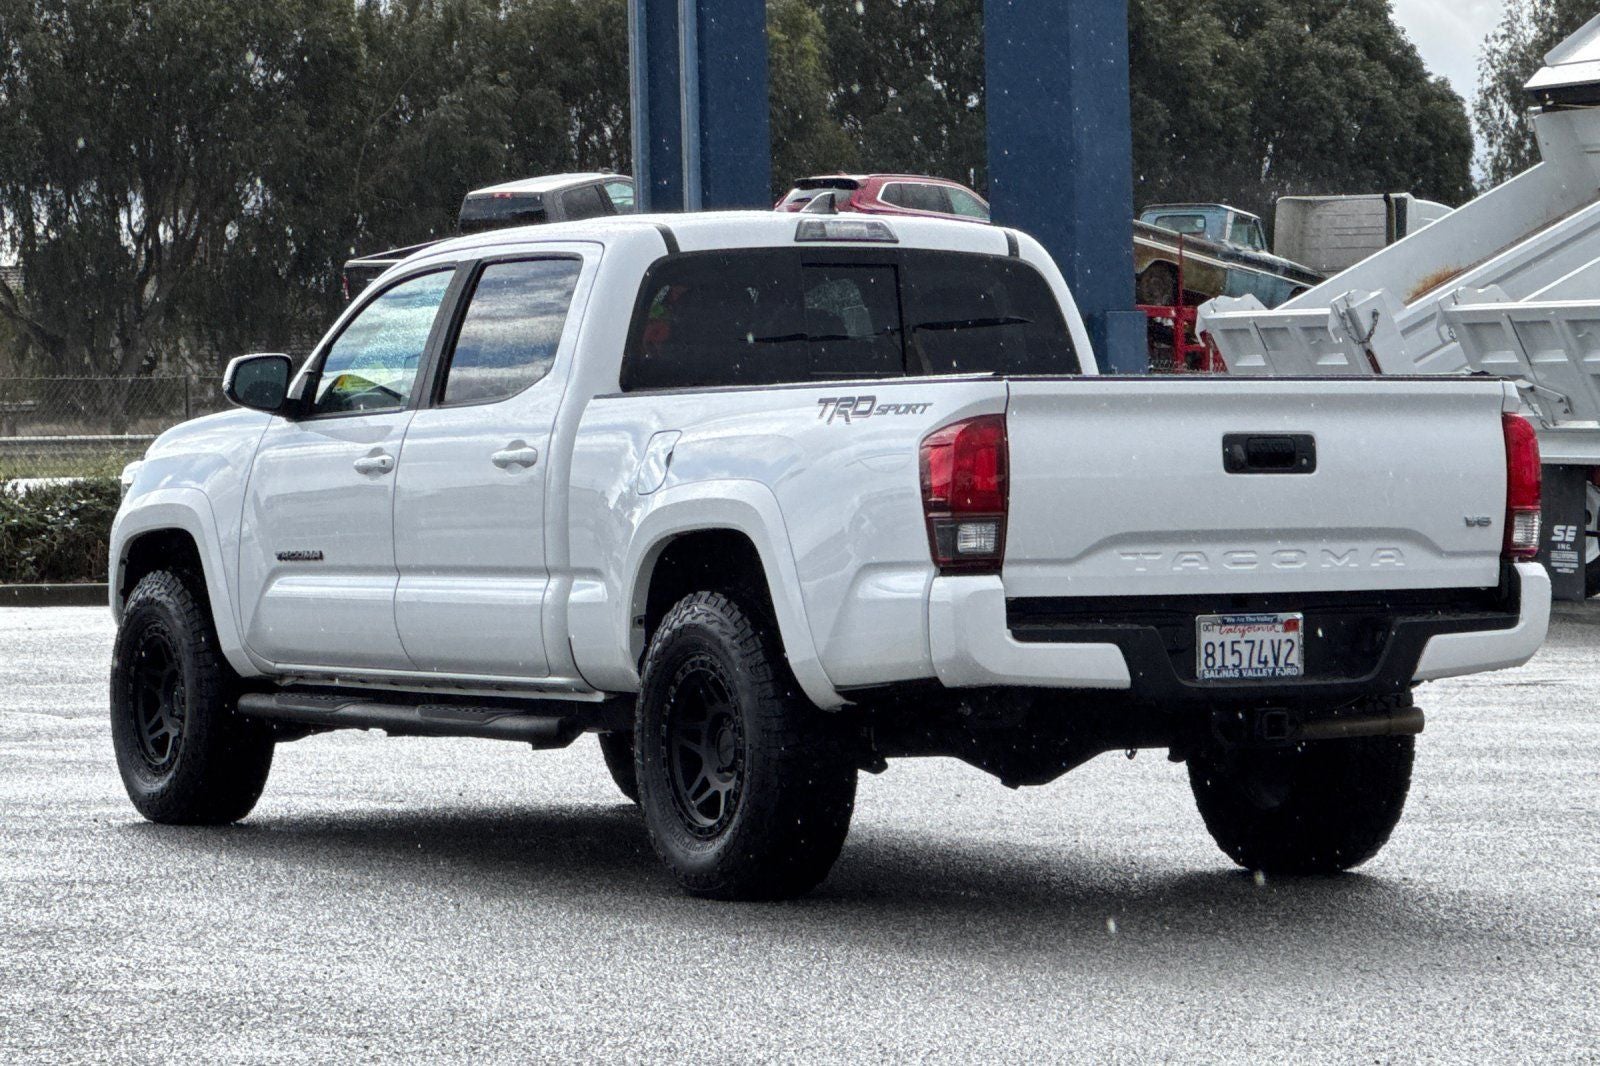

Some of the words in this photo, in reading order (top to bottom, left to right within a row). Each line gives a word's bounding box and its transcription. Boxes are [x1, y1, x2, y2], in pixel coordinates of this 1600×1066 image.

[818, 395, 877, 425] TRD
[873, 402, 934, 416] SPORT
[1464, 516, 1492, 527] V6
[1551, 525, 1577, 542] SE
[1119, 547, 1405, 571] TACOMA
[1219, 623, 1278, 638] California
[1204, 638, 1296, 669] 81574V2
[1204, 670, 1239, 679] SALINAS
[1242, 669, 1273, 678] VALLEY
